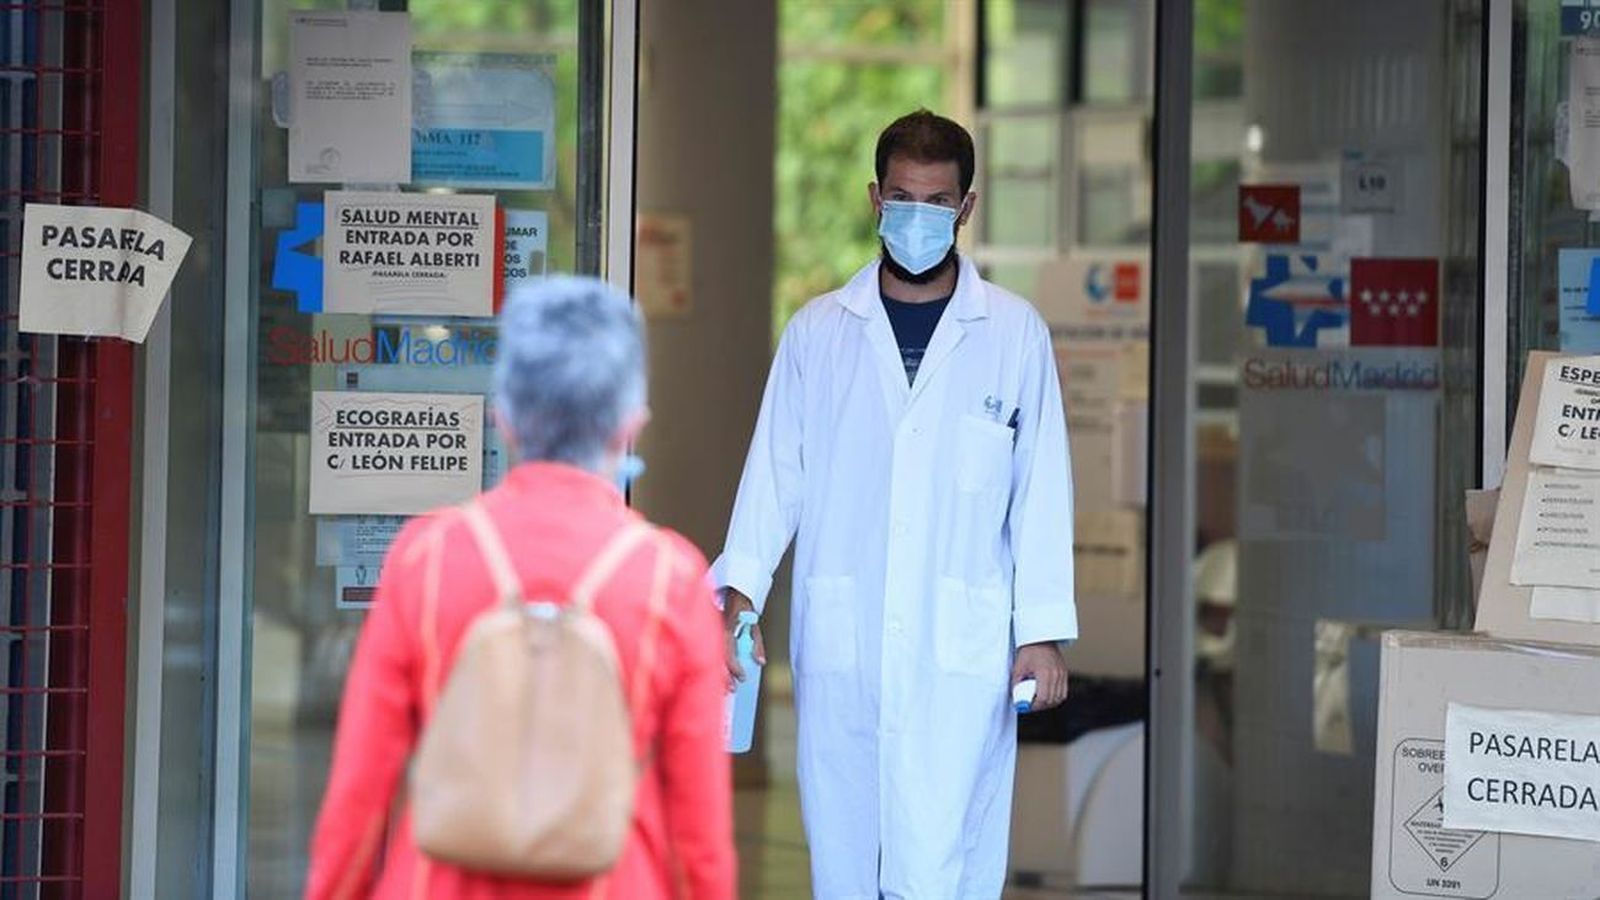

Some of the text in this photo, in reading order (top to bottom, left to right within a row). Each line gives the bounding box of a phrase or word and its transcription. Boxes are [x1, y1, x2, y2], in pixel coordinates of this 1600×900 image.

[341, 208, 479, 226] SALUD MENTAL
[345, 230, 473, 247] ENTRADA POR
[339, 251, 480, 268] RAFAEL ALBERTI
[335, 406, 461, 427] ECOGRAFÍAS
[327, 432, 467, 449] ENTRADA POR
[1580, 426, 1600, 440] LE
[327, 450, 468, 472] C/ LEÓN FELIPE
[1469, 731, 1600, 765] PASARELA
[1467, 777, 1599, 812] CERRADA
[1440, 857, 1449, 868] 6
